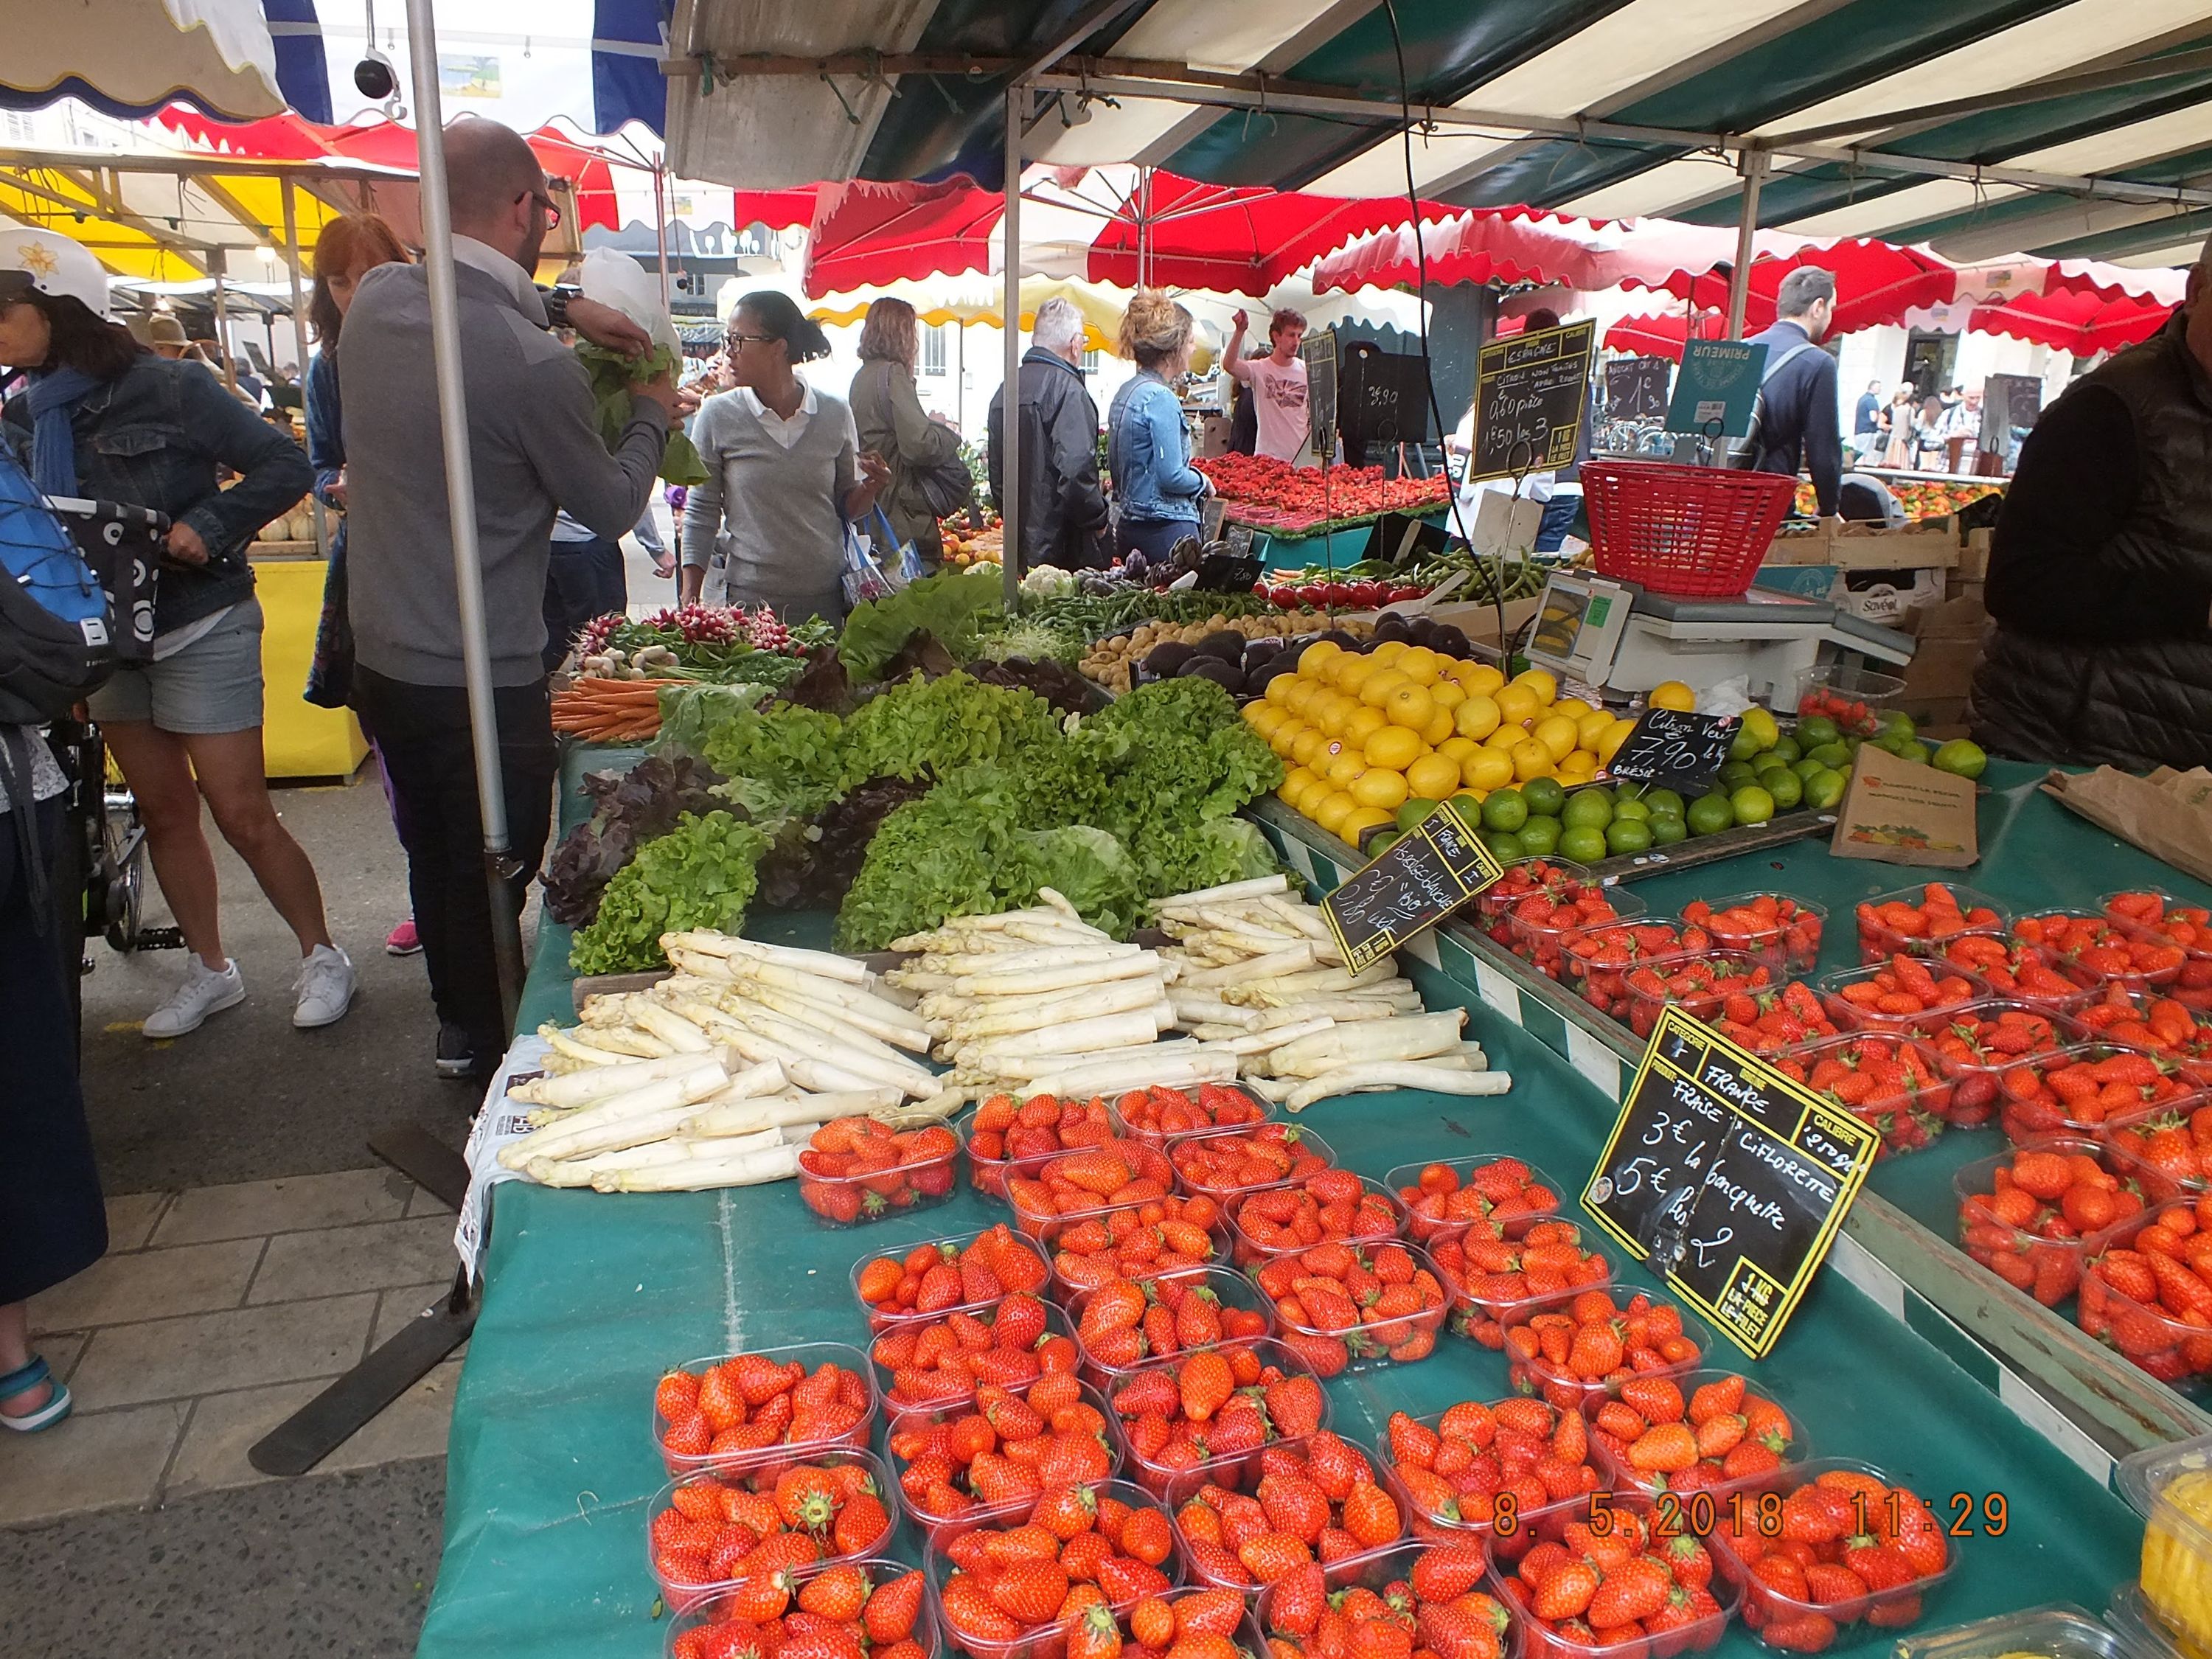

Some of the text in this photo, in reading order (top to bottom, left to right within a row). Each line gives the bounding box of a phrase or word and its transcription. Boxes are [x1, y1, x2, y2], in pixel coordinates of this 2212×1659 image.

[1694, 346, 1750, 361] PRIMEUR
[1862, 599, 1898, 613] Savéol
[1668, 1021, 1706, 1051] CATEGORIE
[1705, 1065, 1770, 1114] FRANCE
[1814, 1114, 1857, 1147] CALIBRE
